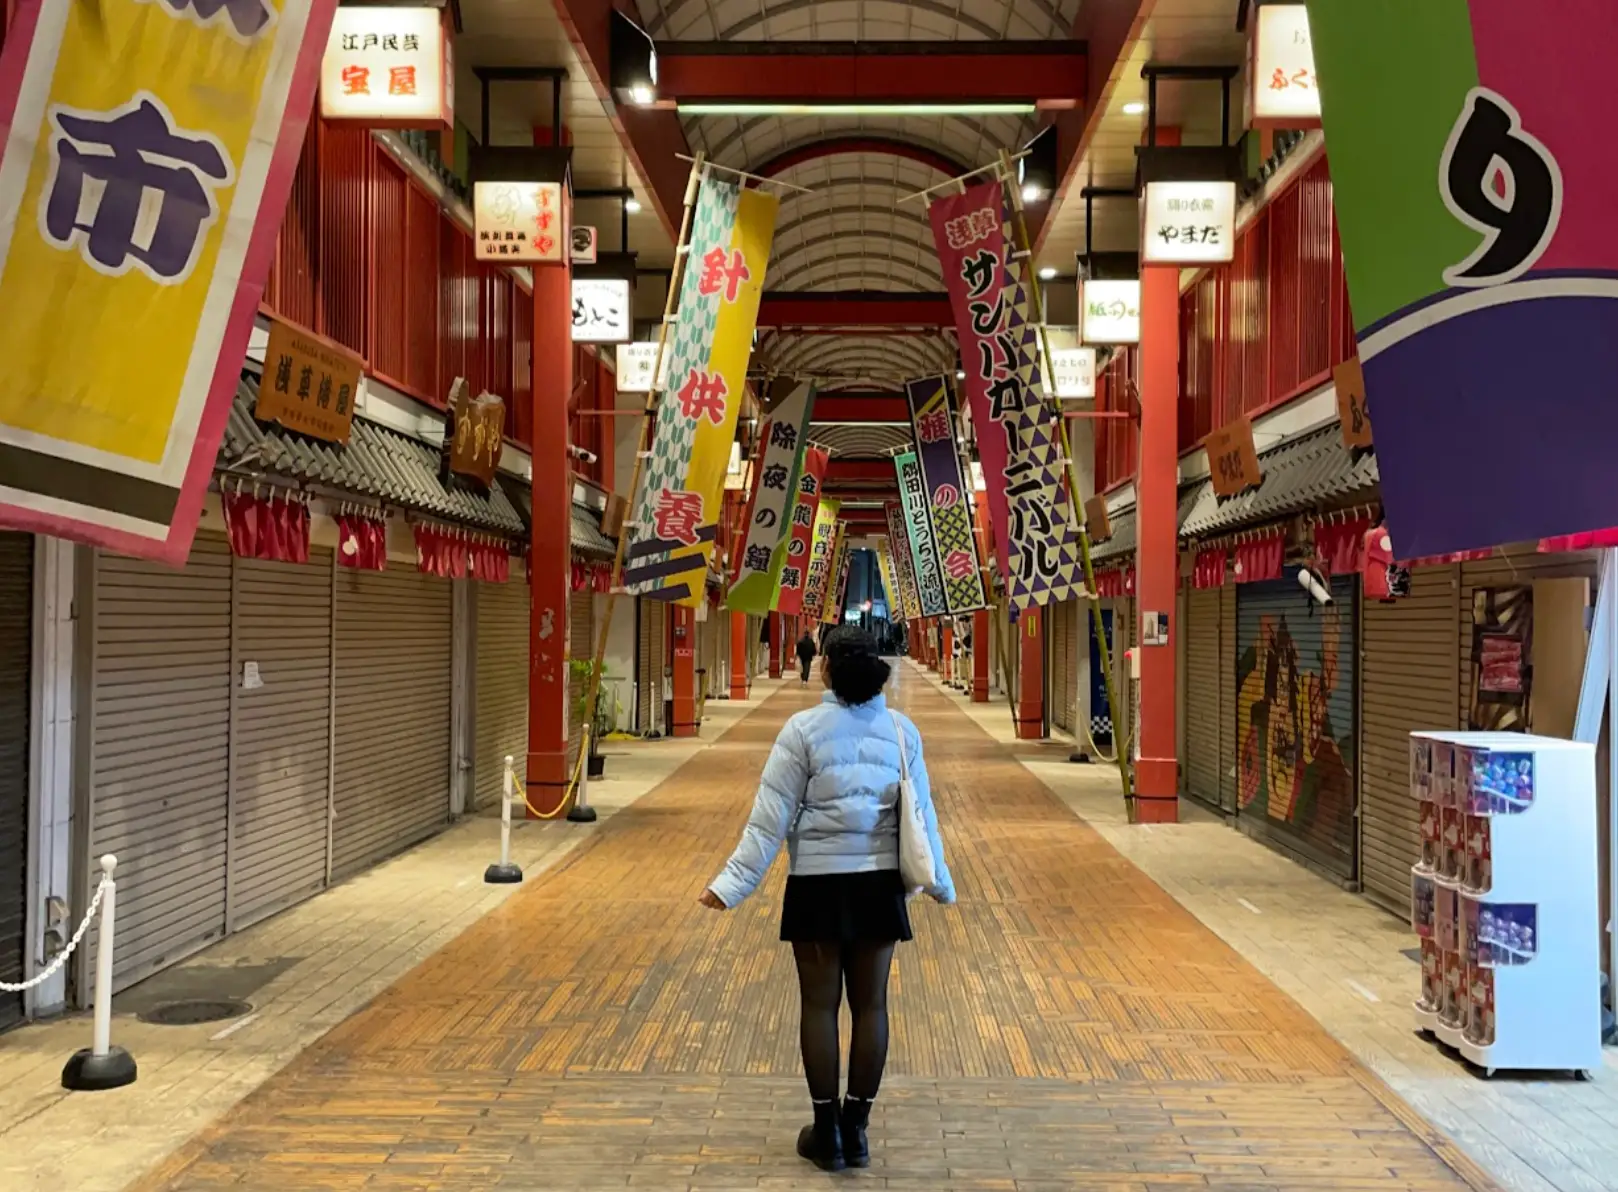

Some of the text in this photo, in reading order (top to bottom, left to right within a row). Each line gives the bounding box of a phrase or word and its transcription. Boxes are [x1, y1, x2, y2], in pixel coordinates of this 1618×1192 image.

[342, 33, 419, 51] 江戸民芸
[341, 65, 418, 95] 宝屋
[1268, 68, 1319, 90] ふく
[1447, 95, 1554, 278] り
[532, 188, 555, 256] すずや
[946, 209, 998, 249] 浅草
[1158, 225, 1222, 245] やまだ
[653, 246, 750, 544] 針供養
[961, 250, 1060, 582] サンバカーニバル
[744, 421, 797, 574] 除夜の鐘
[780, 472, 819, 590] 金龍の舞
